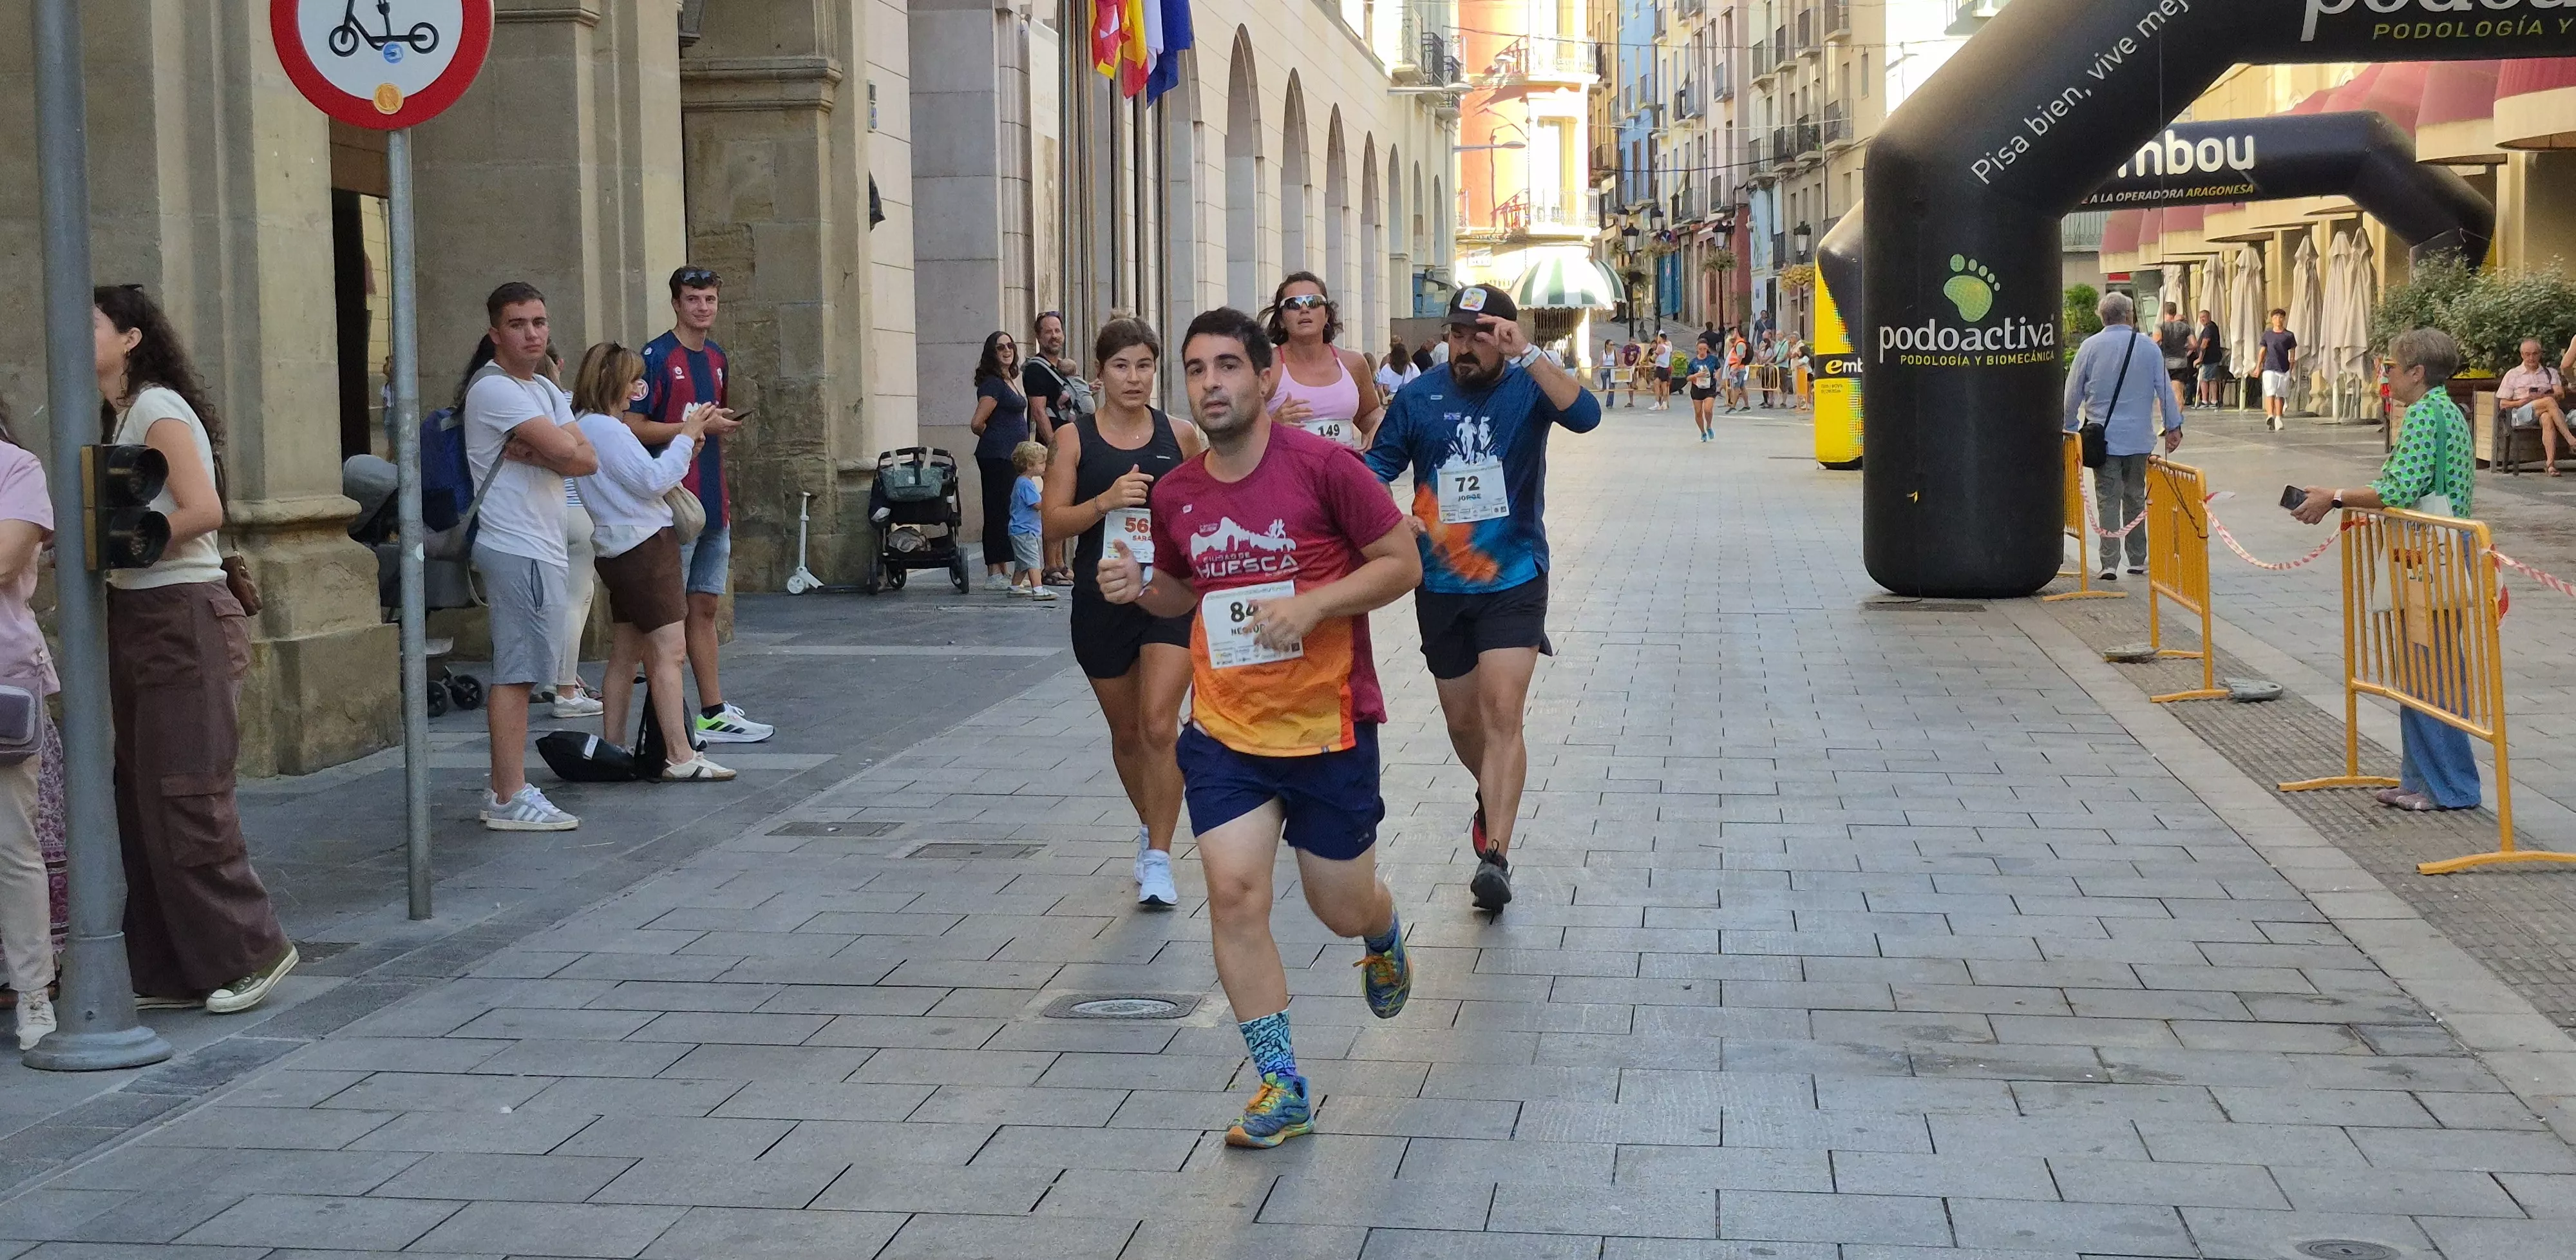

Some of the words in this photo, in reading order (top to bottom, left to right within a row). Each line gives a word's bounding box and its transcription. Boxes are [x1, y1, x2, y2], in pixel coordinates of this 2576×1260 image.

[2372, 15, 2543, 40] PODOLOGÍA
[2559, 18, 2574, 34] Y
[1971, 135, 2030, 185] Pisa
[2023, 86, 2092, 137] bien,
[2087, 36, 2137, 81] vive
[2089, 193, 2098, 204] A
[2100, 193, 2113, 203] LA
[2116, 188, 2184, 202] OPERADORA
[2186, 183, 2253, 197] ARAGONESA
[1879, 316, 2054, 364] podoactiva
[1900, 353, 1970, 366] PODOLOGÍA
[1975, 356, 1982, 366] Y
[1986, 350, 2054, 366] BIOMECÁNICA
[1318, 424, 1340, 437] 149
[1455, 475, 1480, 492] 72
[1196, 554, 1298, 578] HUESCA
